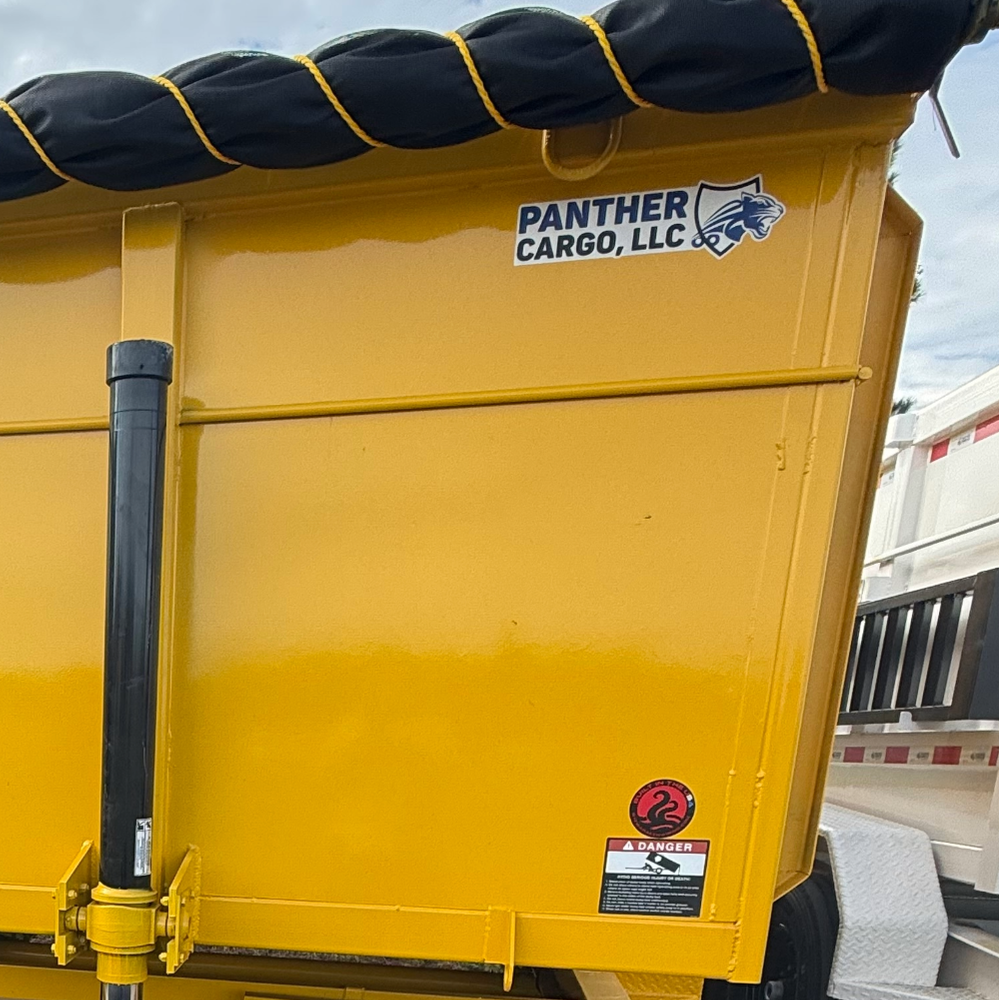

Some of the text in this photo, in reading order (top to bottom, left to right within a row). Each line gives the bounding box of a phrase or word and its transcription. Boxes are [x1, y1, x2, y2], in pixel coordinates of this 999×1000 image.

[518, 189, 690, 235] PANTHER
[516, 223, 687, 262] CARGO, LLC
[638, 842, 693, 852] DANGER
